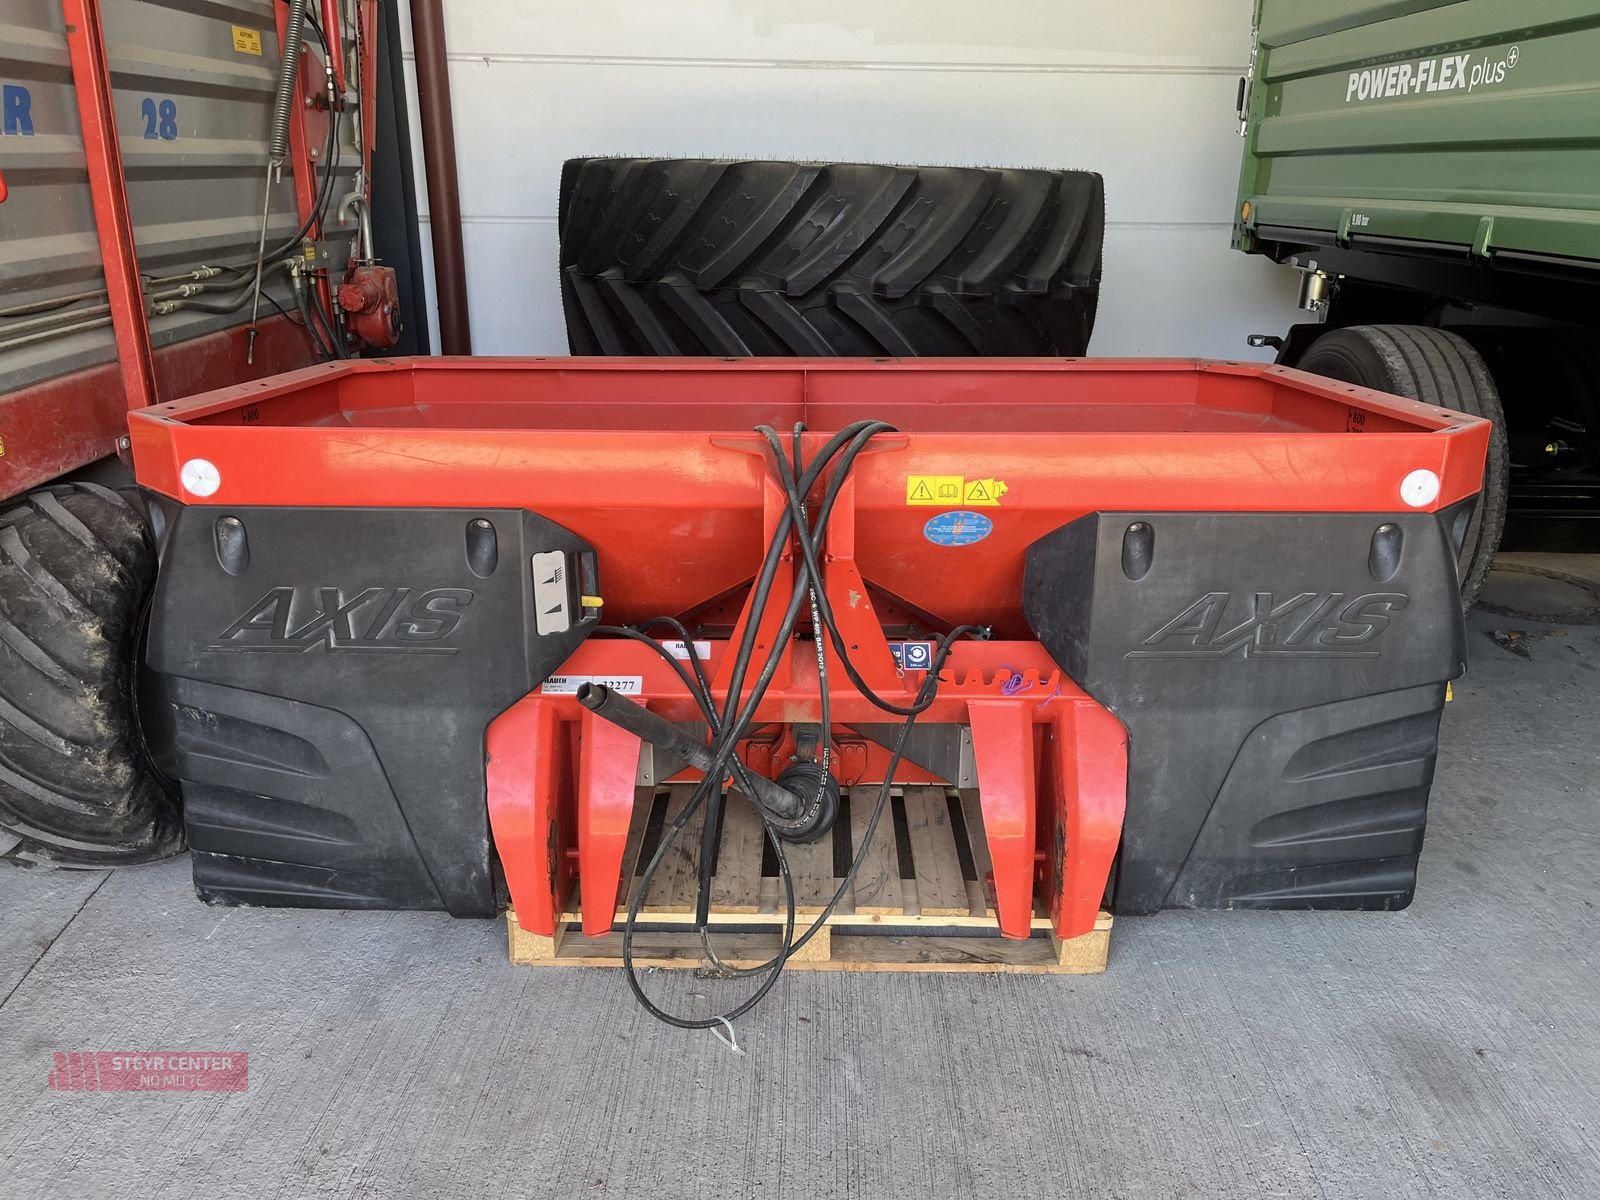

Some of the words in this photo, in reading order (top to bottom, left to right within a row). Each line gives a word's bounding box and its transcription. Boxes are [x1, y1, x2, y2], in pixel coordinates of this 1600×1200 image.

[1345, 54, 1470, 103] POWER-FLEX
[1468, 56, 1506, 93] plus
[0, 84, 35, 136] R
[141, 97, 178, 141] 28
[1352, 411, 1366, 426] 800
[217, 586, 475, 641] AXIS
[1142, 591, 1410, 646] AXIS
